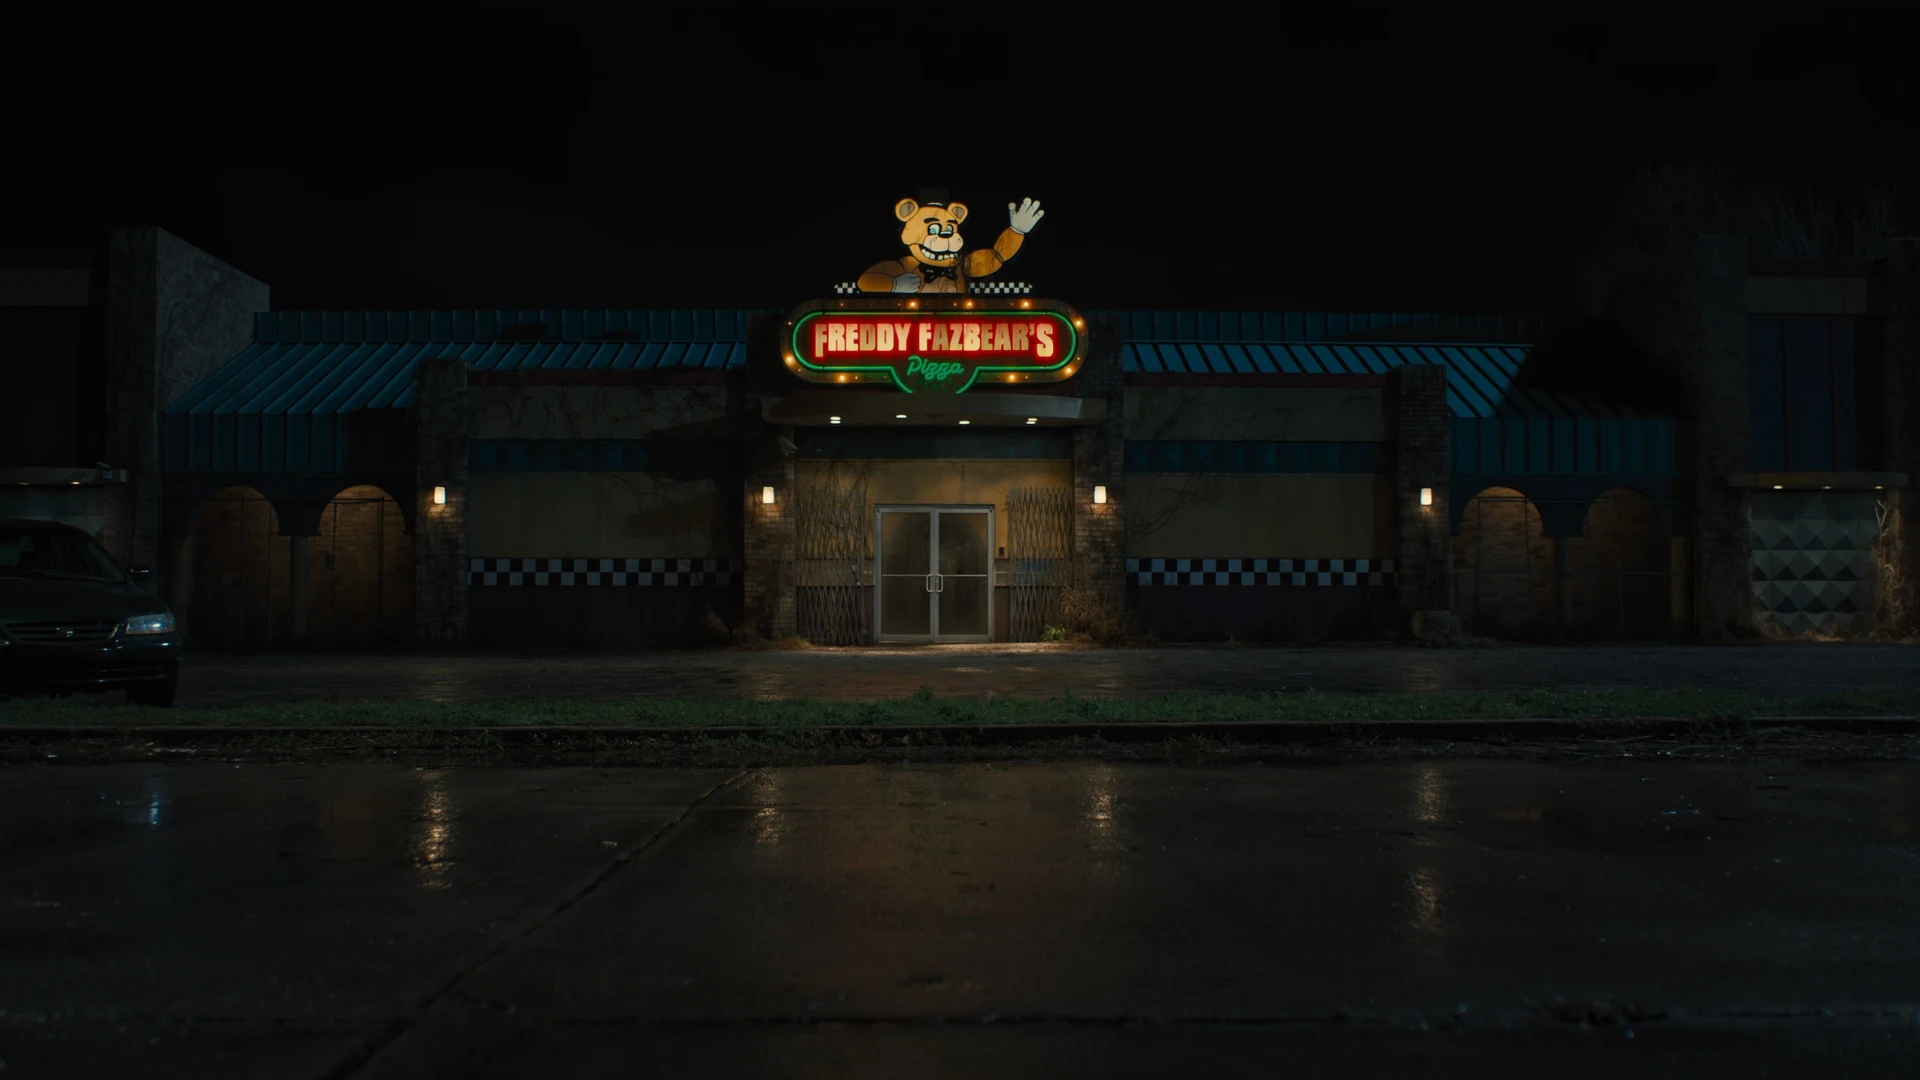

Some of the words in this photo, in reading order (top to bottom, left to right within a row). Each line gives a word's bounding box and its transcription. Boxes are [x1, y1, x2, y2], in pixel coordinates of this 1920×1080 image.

[815, 323, 911, 357] FREDDY
[919, 323, 1054, 357] FAZBEAR'S
[907, 355, 964, 380] Pizza
